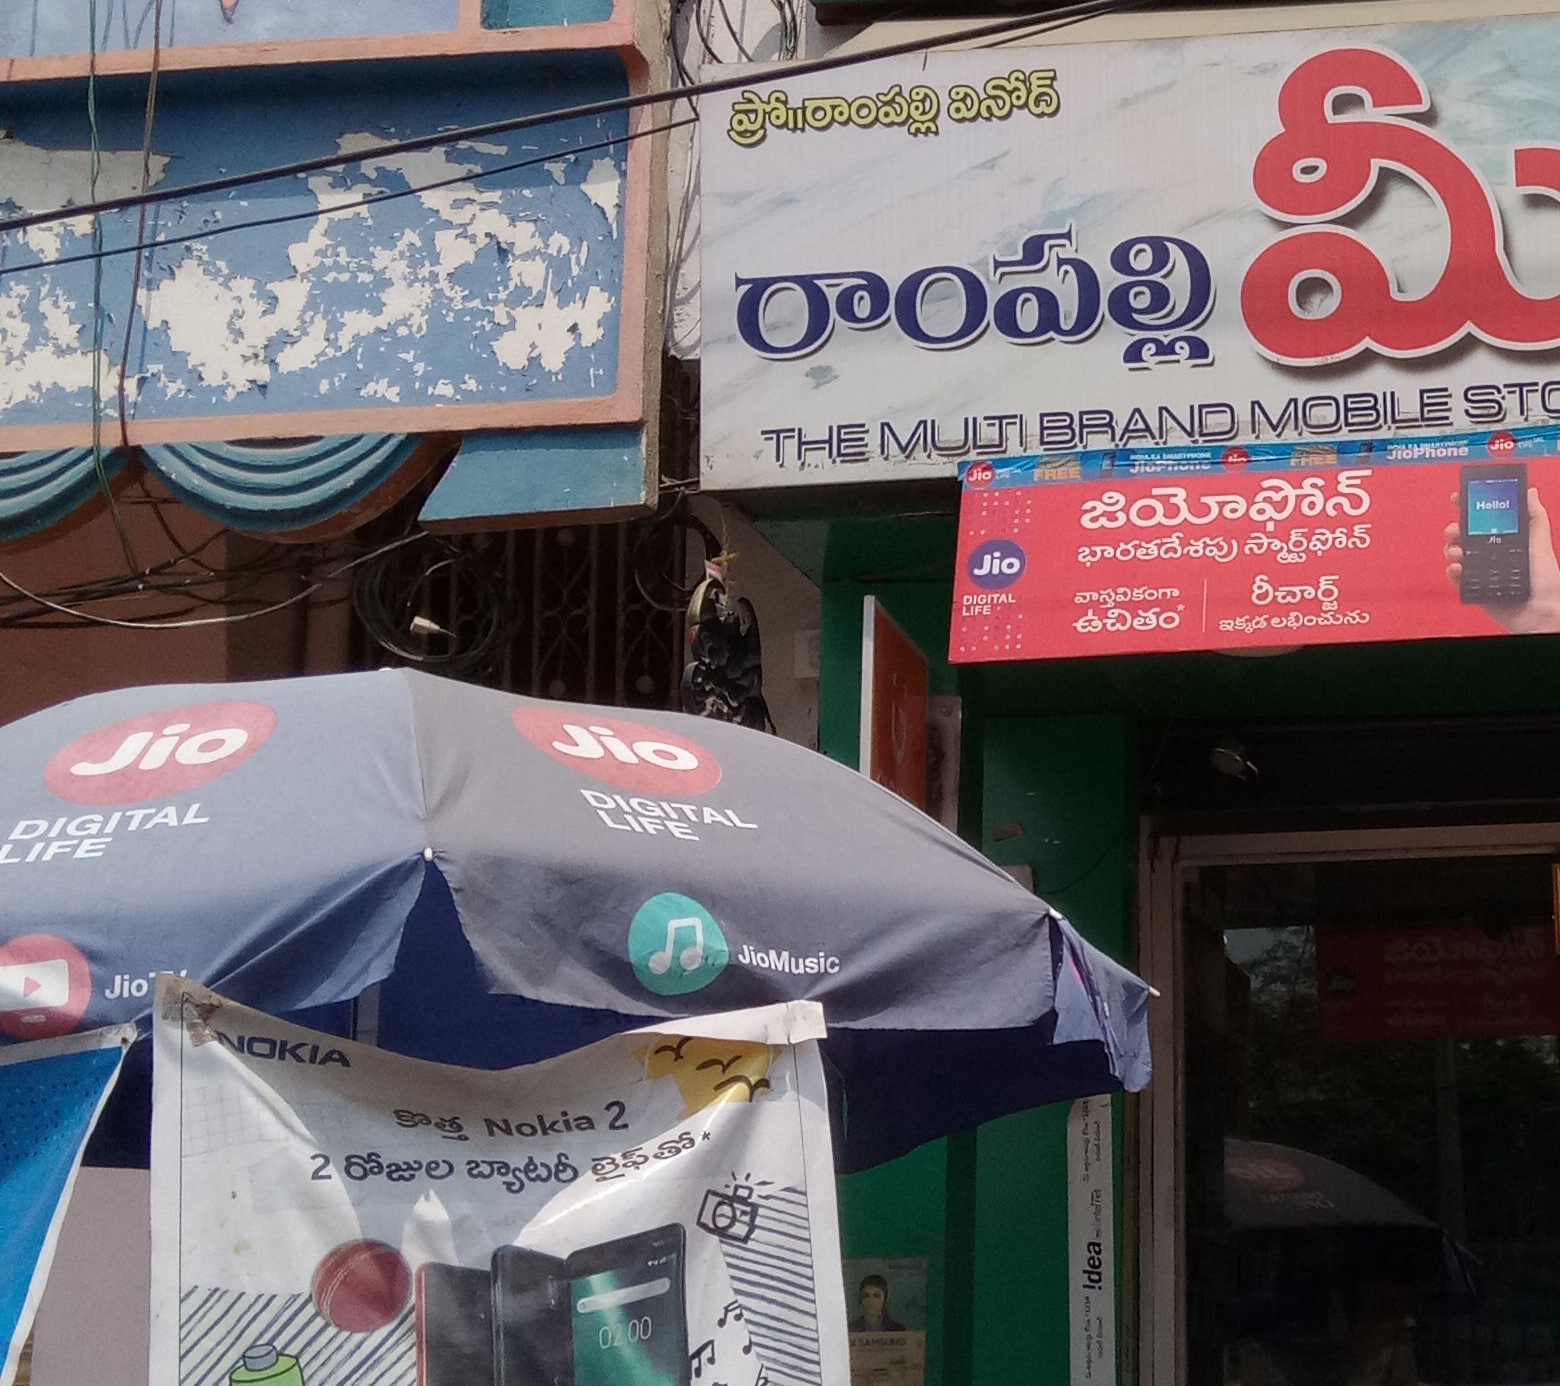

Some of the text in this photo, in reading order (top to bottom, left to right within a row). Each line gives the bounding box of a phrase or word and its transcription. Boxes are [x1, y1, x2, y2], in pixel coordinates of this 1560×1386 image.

[947, 69, 1061, 121] వినోద్
[734, 223, 1214, 367] రాంపల్లి
[760, 423, 869, 463] THE
[879, 413, 1027, 460] MULTI
[1038, 403, 1238, 447] BRAND
[1250, 385, 1452, 437] MOBILE
[1489, 439, 1516, 452] Jio
[967, 466, 993, 482] Jio
[1079, 469, 1373, 535] జియోఫోన్
[1475, 498, 1511, 512] Hello!
[972, 550, 1023, 578] Jio
[1076, 532, 1239, 564] భారతదేశపు
[961, 594, 1017, 607] DIGITAL
[1250, 574, 1341, 611] రీచార్జ్
[961, 604, 992, 617] LIFE
[1218, 609, 1371, 633] ఇక్కడ లభించును
[69, 721, 249, 778] Jio
[551, 722, 699, 772] Jio
[8, 802, 210, 842] DIGITAL
[579, 789, 758, 830] DIGITAL
[596, 809, 700, 842] LIFE
[0, 835, 114, 865] LIFE
[737, 944, 841, 976] JioMusic
[394, 1100, 631, 1142] కొత్త Nokia 2
[309, 1153, 580, 1194] 2 రోజుల బ్యాటరీ
